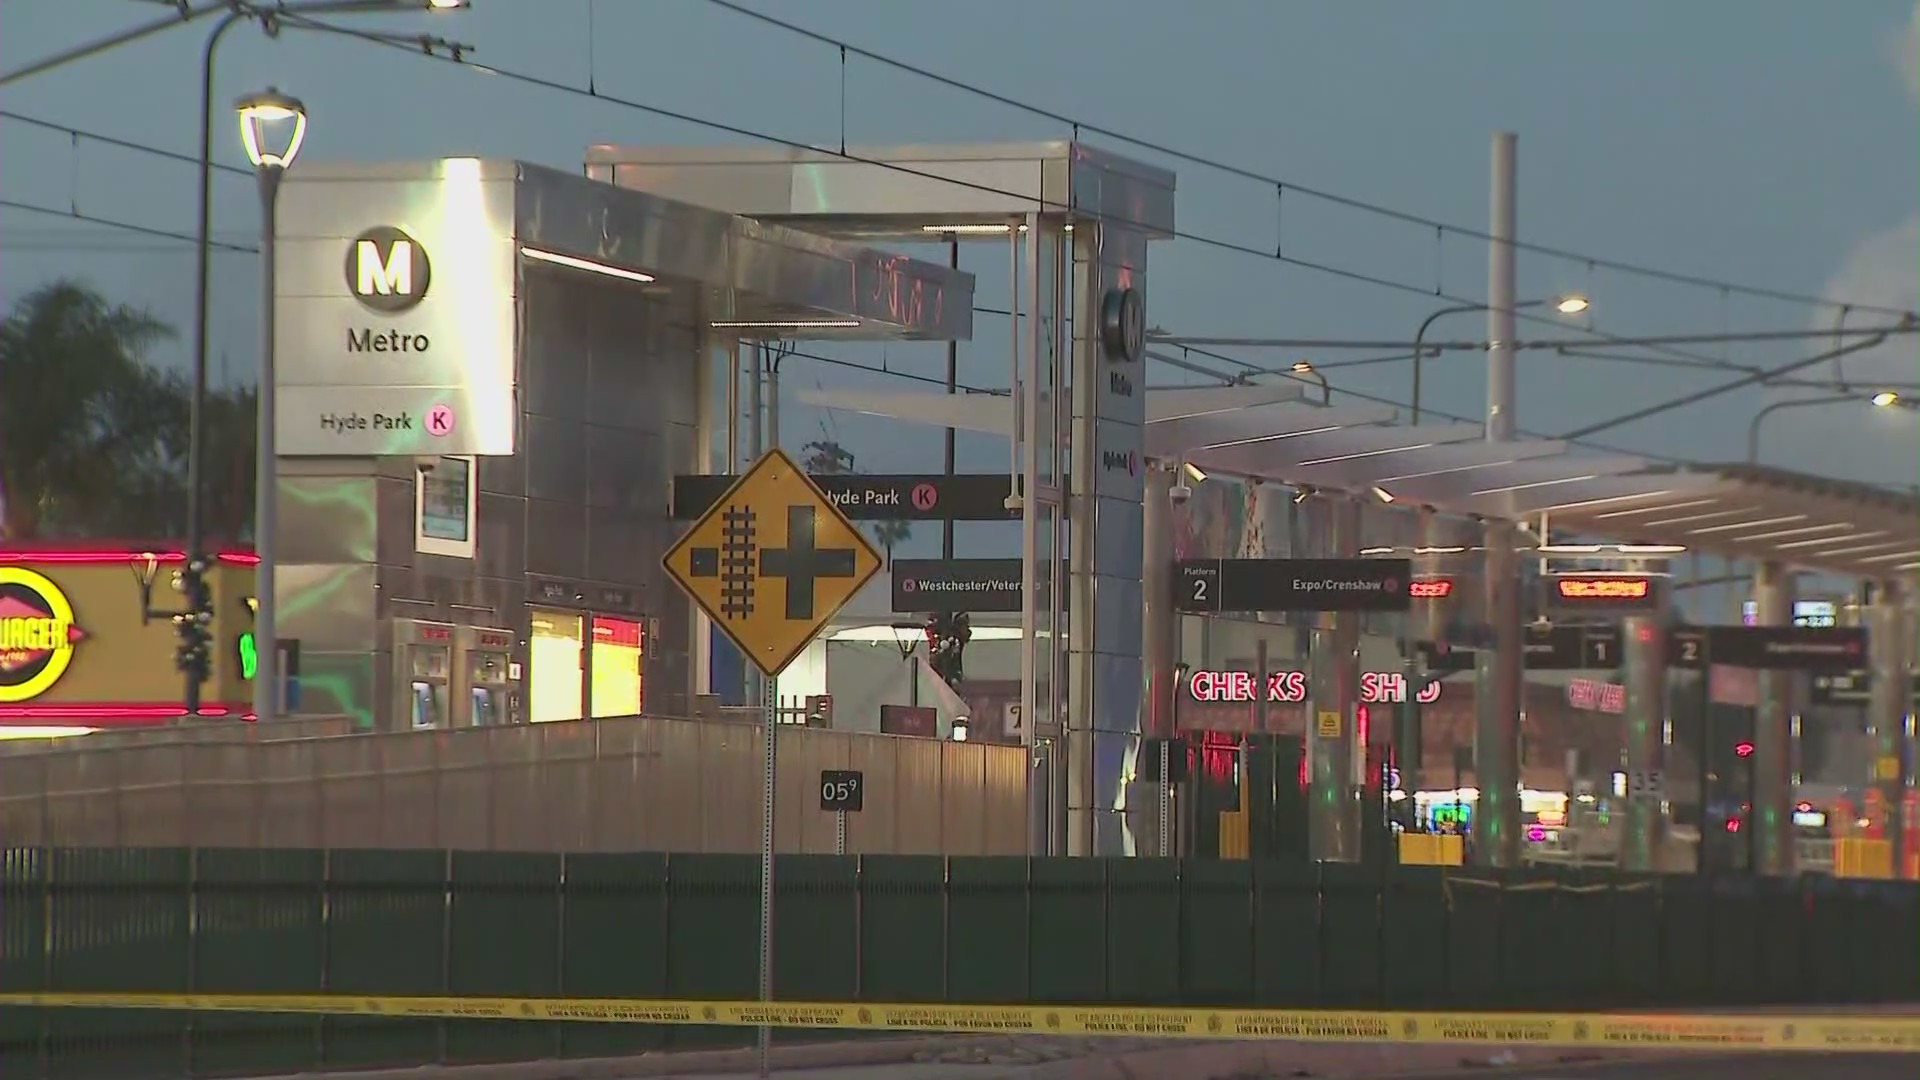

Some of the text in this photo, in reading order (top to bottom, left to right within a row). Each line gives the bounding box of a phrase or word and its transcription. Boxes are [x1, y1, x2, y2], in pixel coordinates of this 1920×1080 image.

[357, 241, 411, 295] M
[347, 328, 429, 352] Metro
[320, 413, 367, 434] Hyde
[373, 413, 412, 430] Park
[865, 488, 899, 505] Park
[1184, 567, 1216, 576] Platform
[1193, 579, 1207, 600] 2
[1292, 579, 1382, 592] Expo/Crenshaw
[1594, 642, 1606, 660] 1
[1681, 642, 1698, 660] 2
